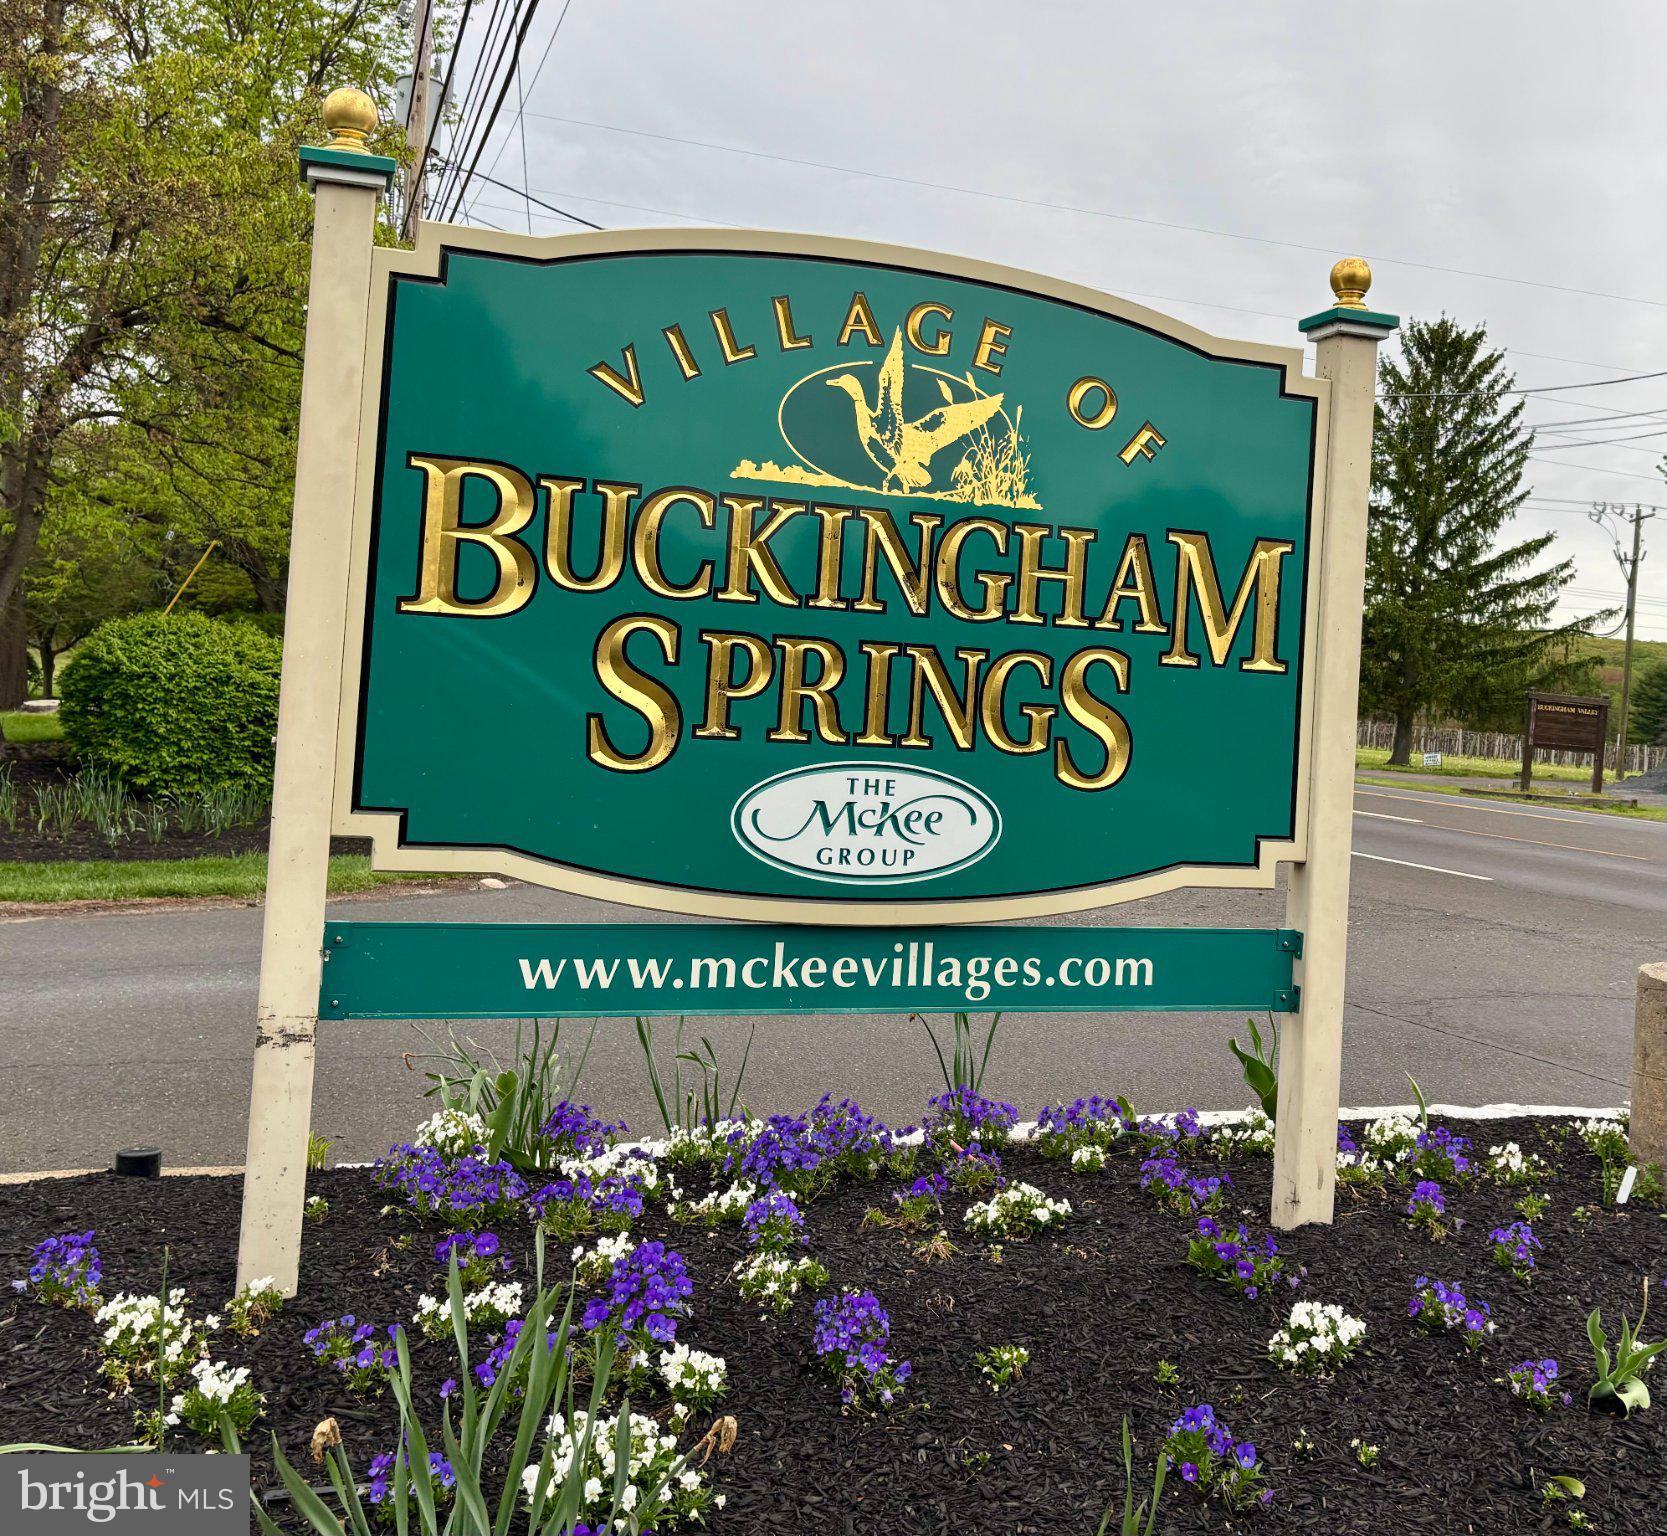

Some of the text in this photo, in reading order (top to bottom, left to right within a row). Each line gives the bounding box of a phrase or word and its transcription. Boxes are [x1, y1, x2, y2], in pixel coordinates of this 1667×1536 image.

[588, 290, 1167, 466] VILLAGE OF
[397, 452, 1295, 674] BUCKINGHAM
[586, 615, 1133, 792] SPRINGS
[1537, 704, 1576, 713] BUCKINGHAM
[846, 777, 896, 796] THE
[770, 797, 955, 844] McKee
[816, 847, 916, 867] GROUP
[516, 941, 1155, 1001] www.mckeevillages.com
